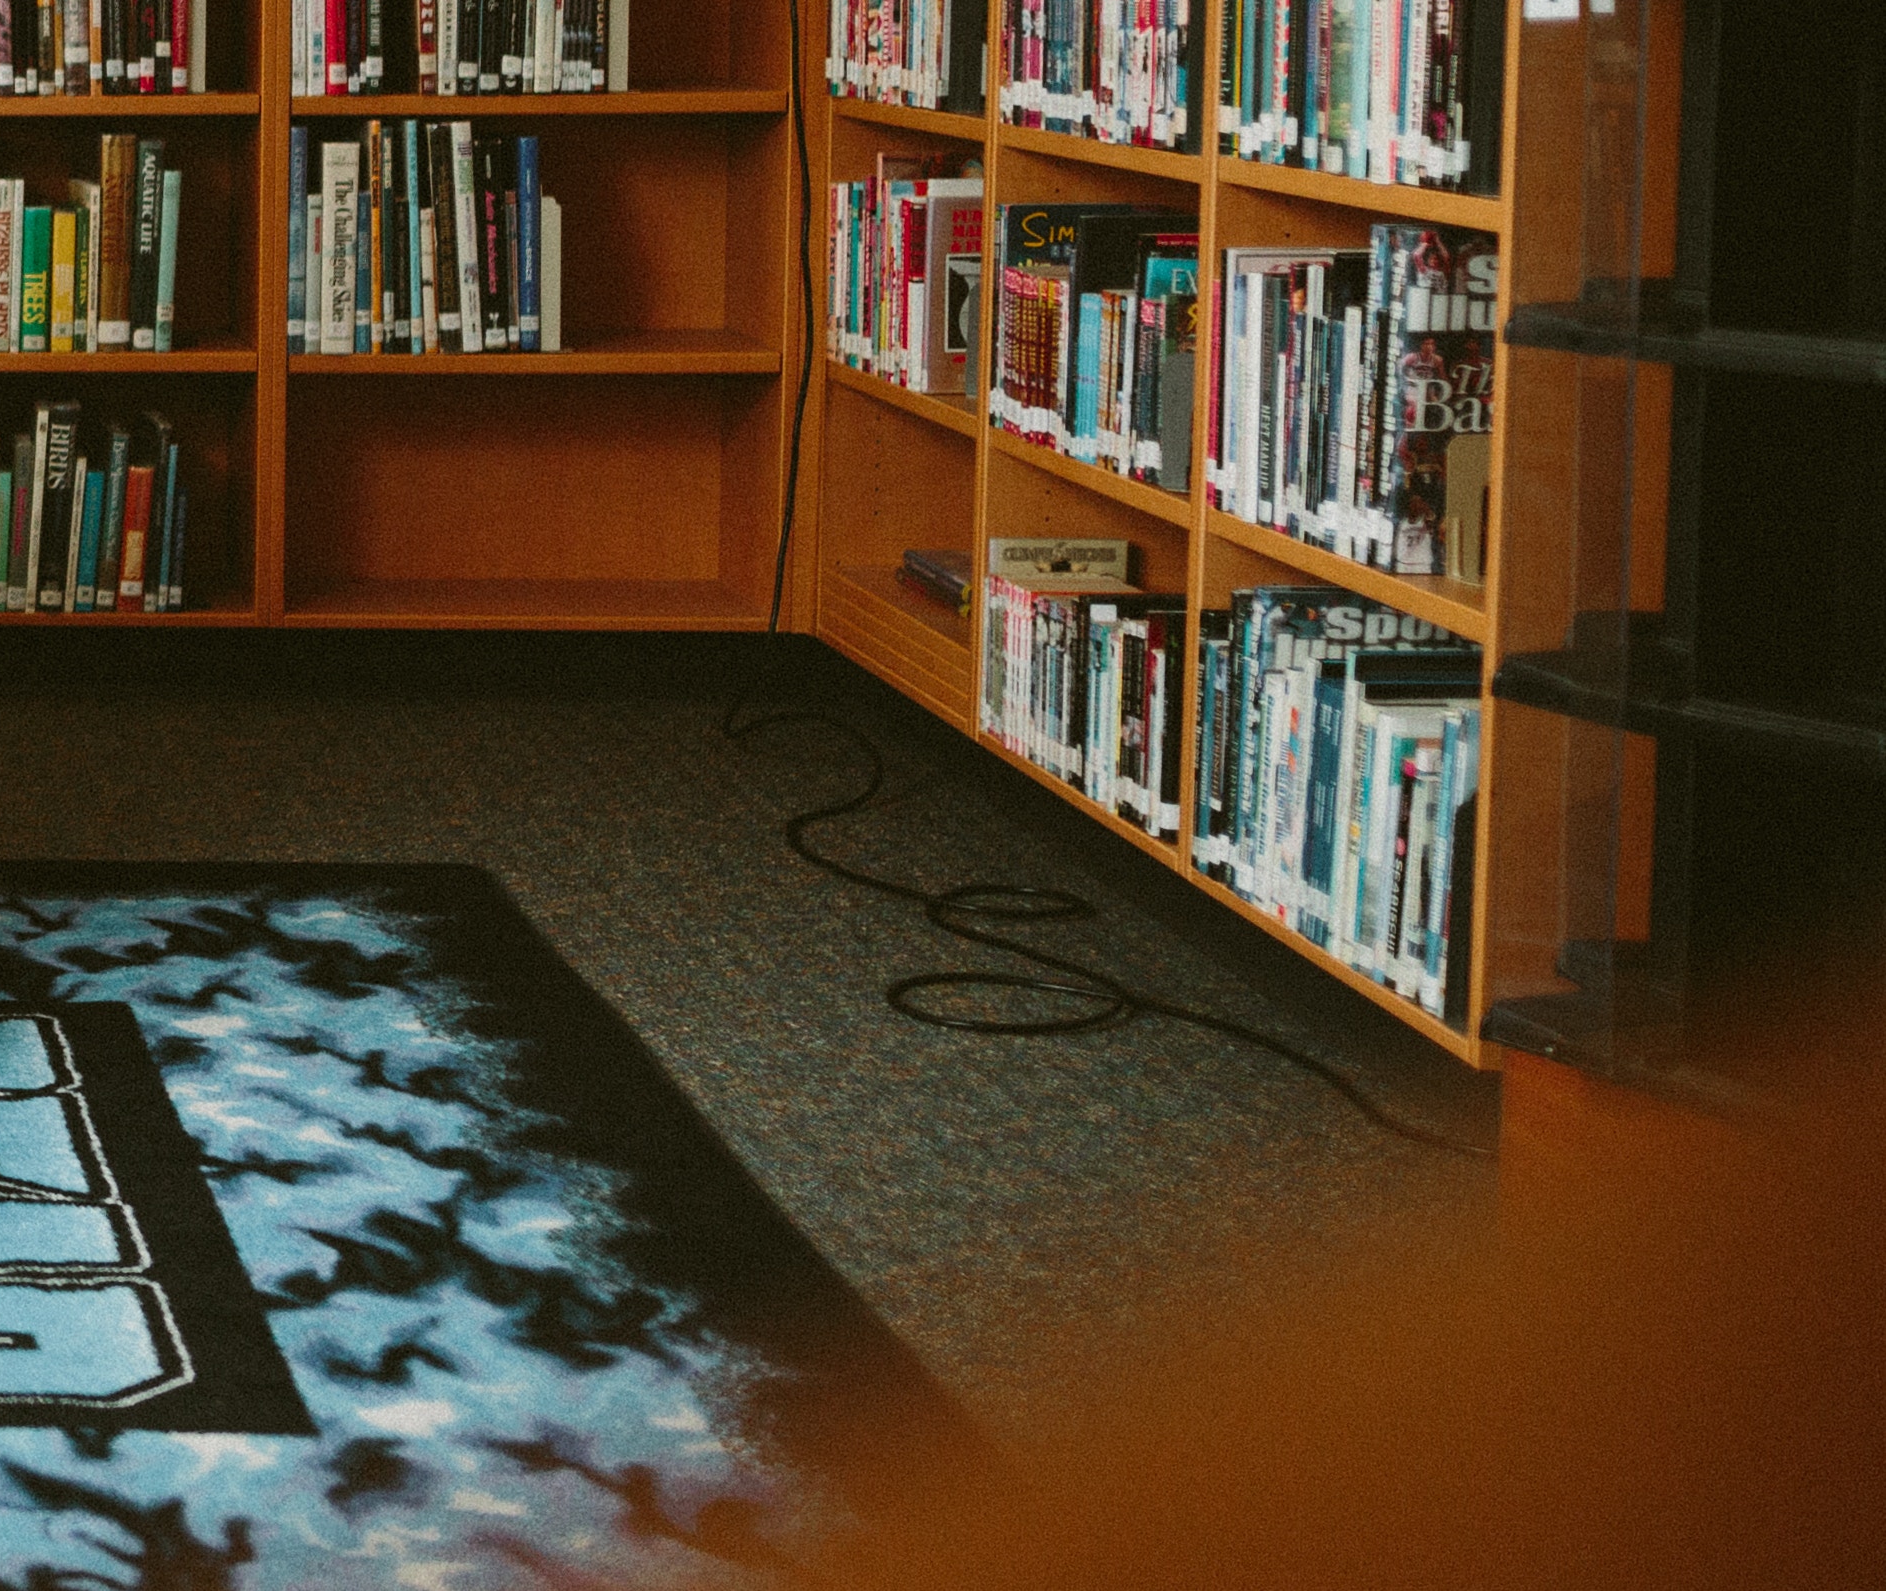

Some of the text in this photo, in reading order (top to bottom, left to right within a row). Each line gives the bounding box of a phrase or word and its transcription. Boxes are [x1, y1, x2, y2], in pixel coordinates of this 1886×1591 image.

[68, 14, 80, 43] MEN
[139, 152, 157, 255] AQUATIC LIFE
[329, 178, 354, 323] The Challenging Skies
[23, 270, 47, 325] TREES
[48, 422, 71, 491] BIRDS
[1263, 693, 1276, 770] Baseball
